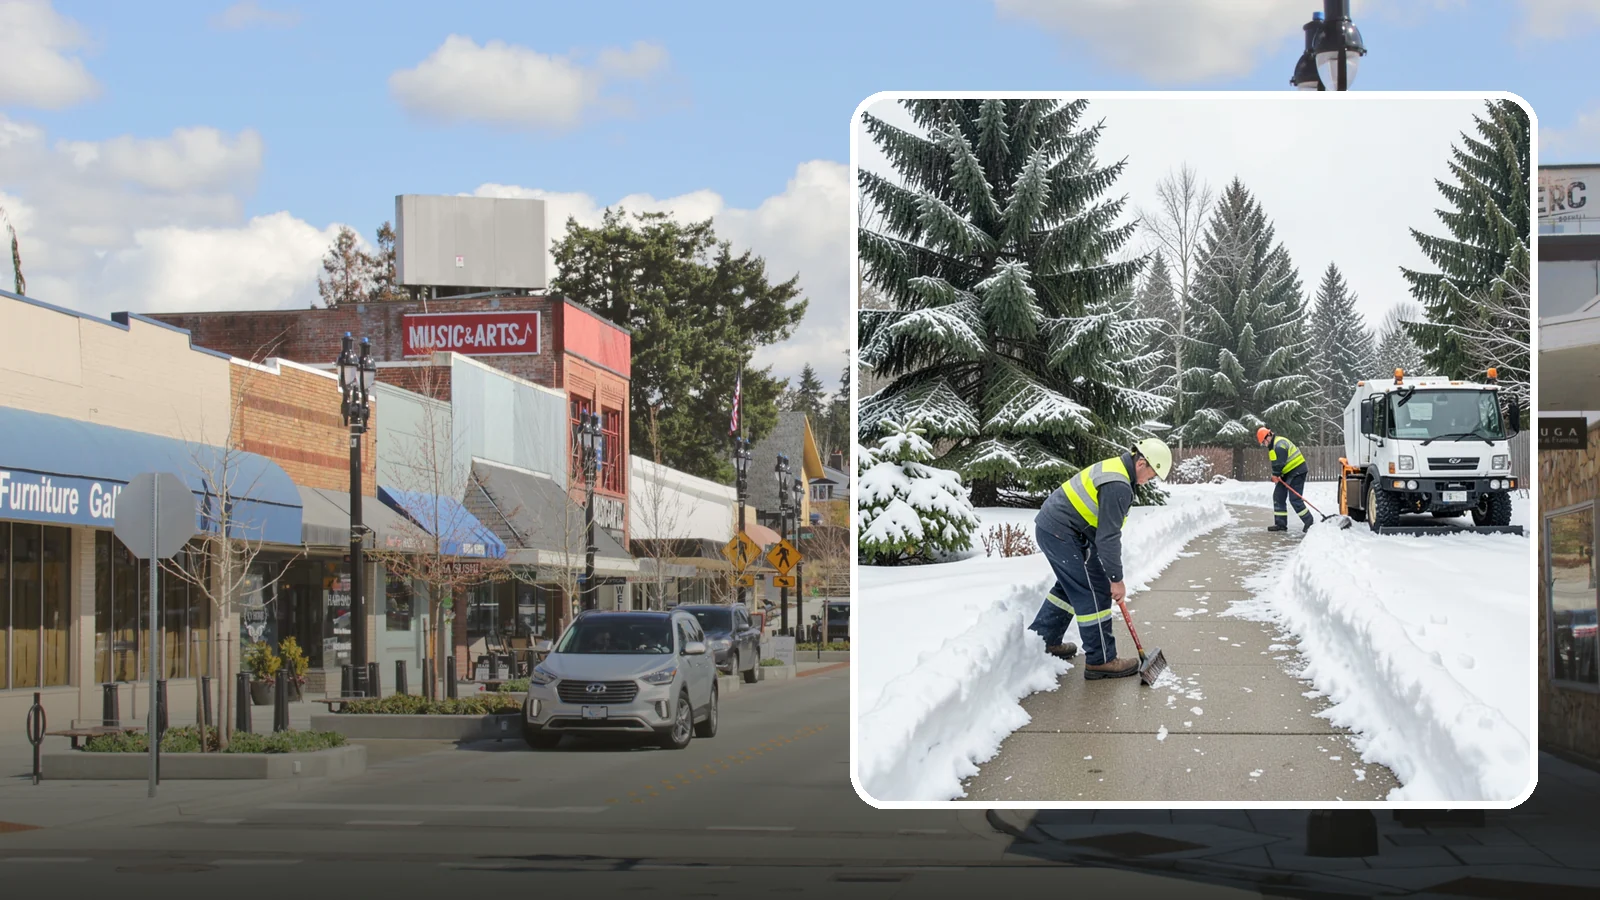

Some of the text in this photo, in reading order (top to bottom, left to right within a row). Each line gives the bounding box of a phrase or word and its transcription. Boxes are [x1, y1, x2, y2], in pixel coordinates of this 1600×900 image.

[409, 323, 519, 348] MUSIC&ARTS
[1540, 427, 1577, 437] UGA
[0, 471, 122, 519] Furniture Gal
[453, 563, 479, 574] SUSHI
